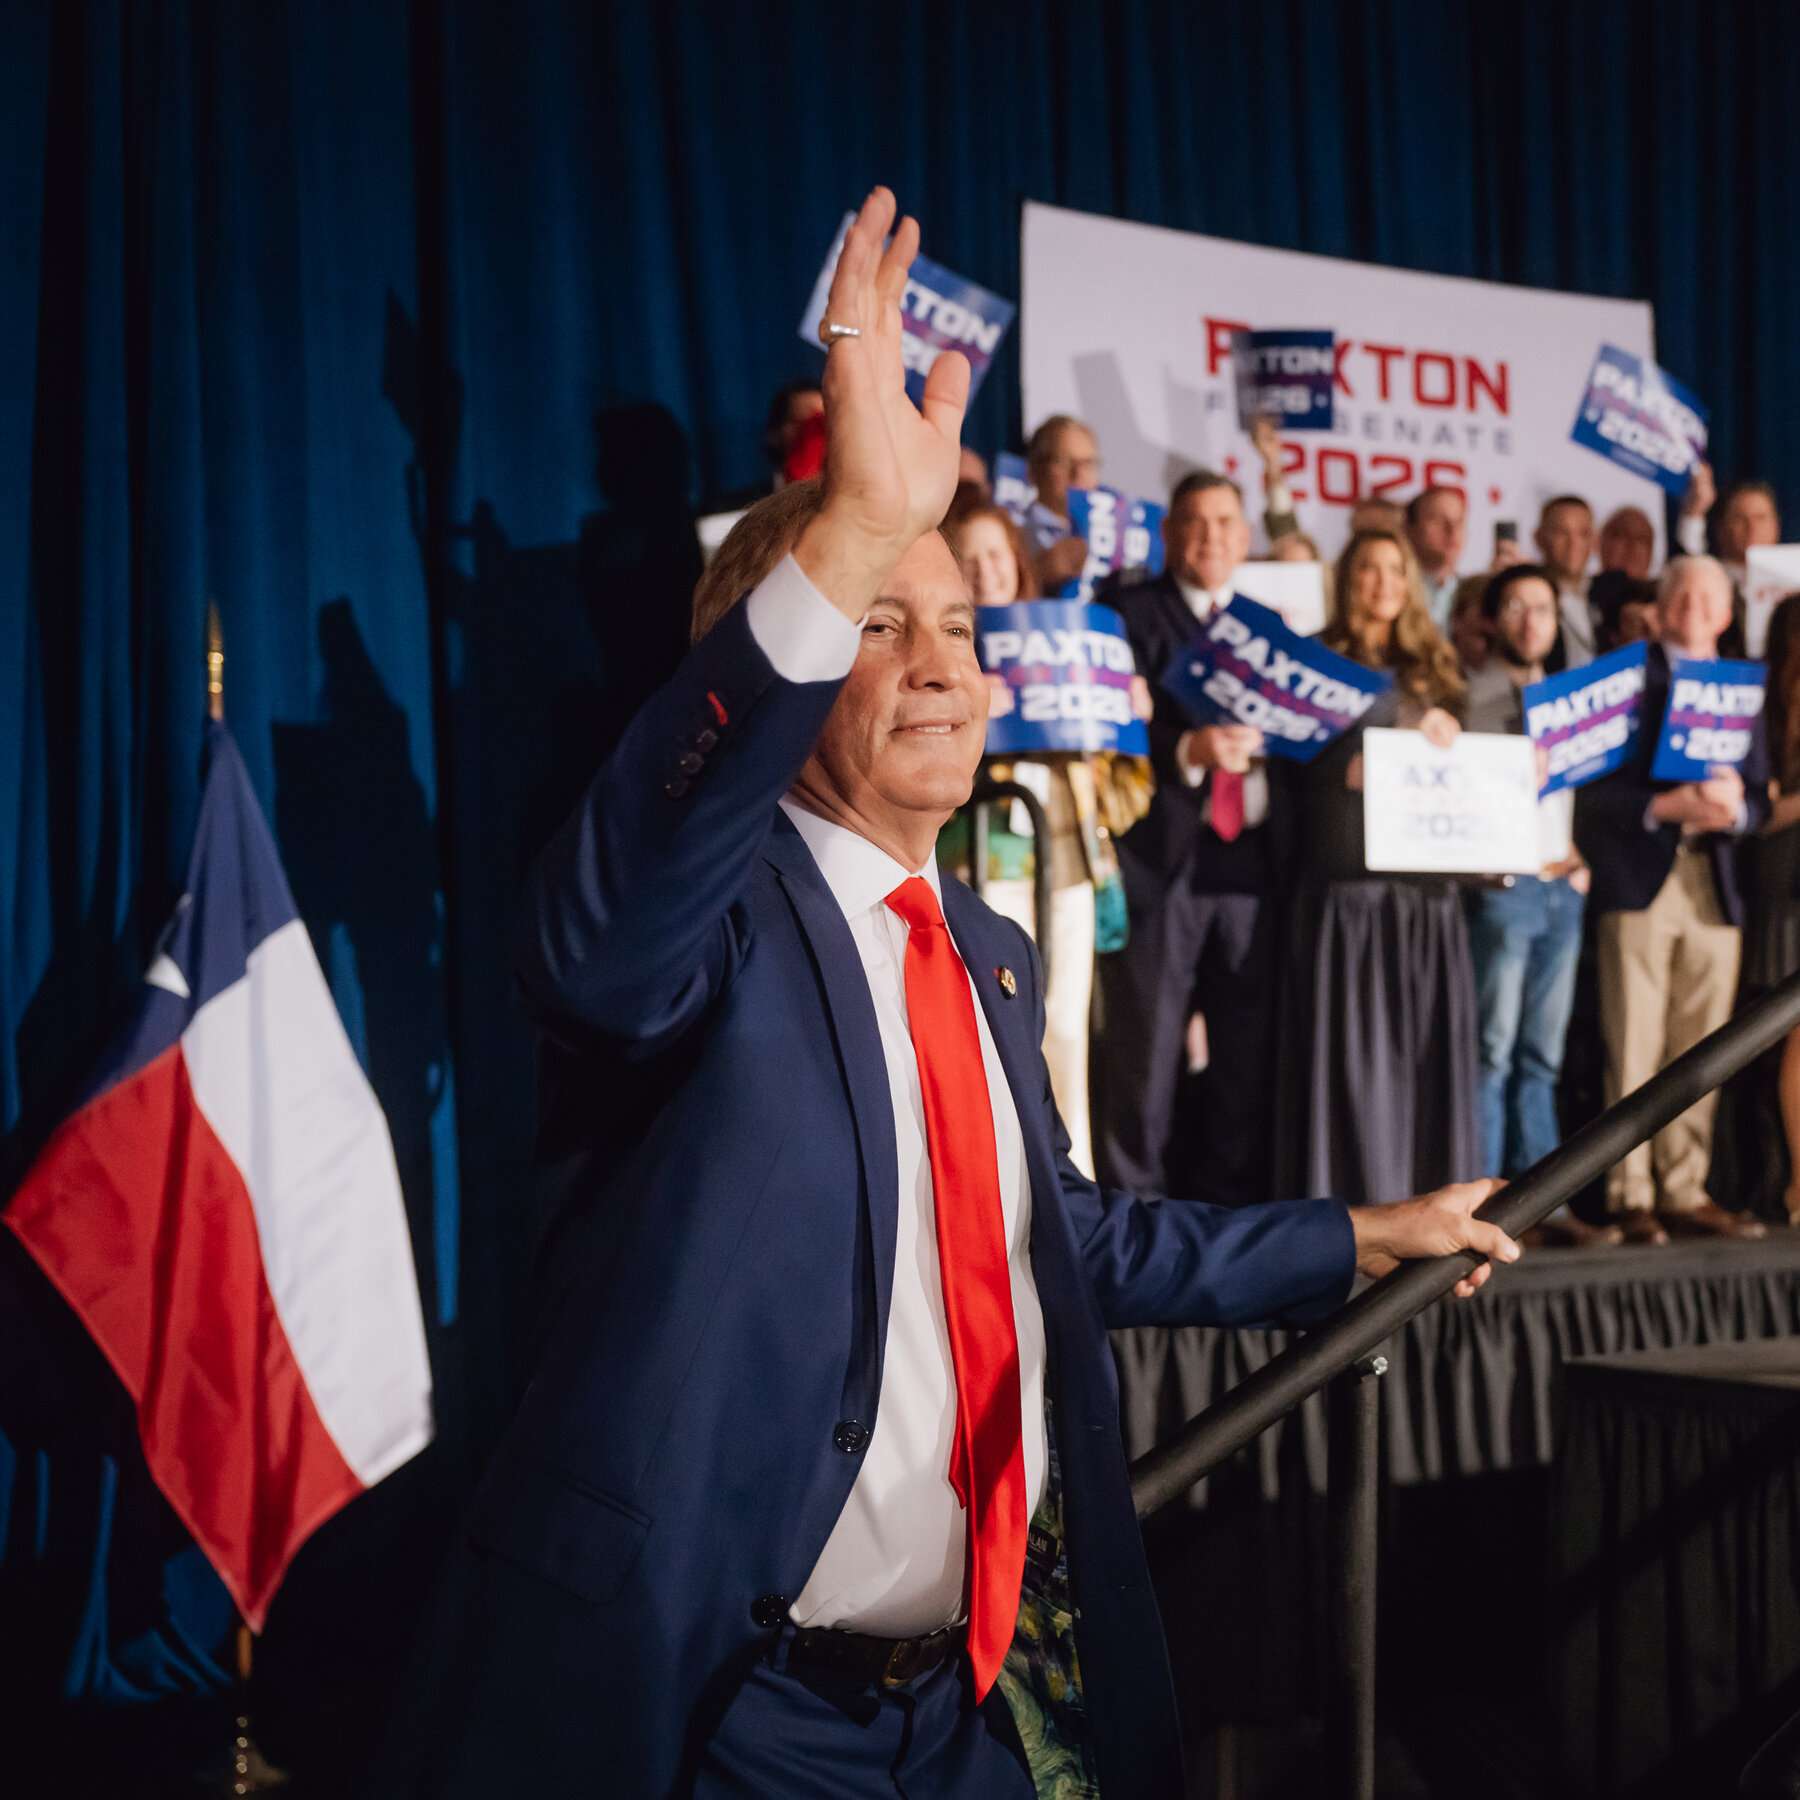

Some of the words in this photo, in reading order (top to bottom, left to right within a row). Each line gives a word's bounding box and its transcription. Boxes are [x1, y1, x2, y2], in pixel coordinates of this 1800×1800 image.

[1203, 317, 1509, 418] PXTON
[1203, 669, 1321, 742] 2026
[1209, 612, 1377, 718] PAXTON
[1527, 665, 1645, 740] PAXTON
